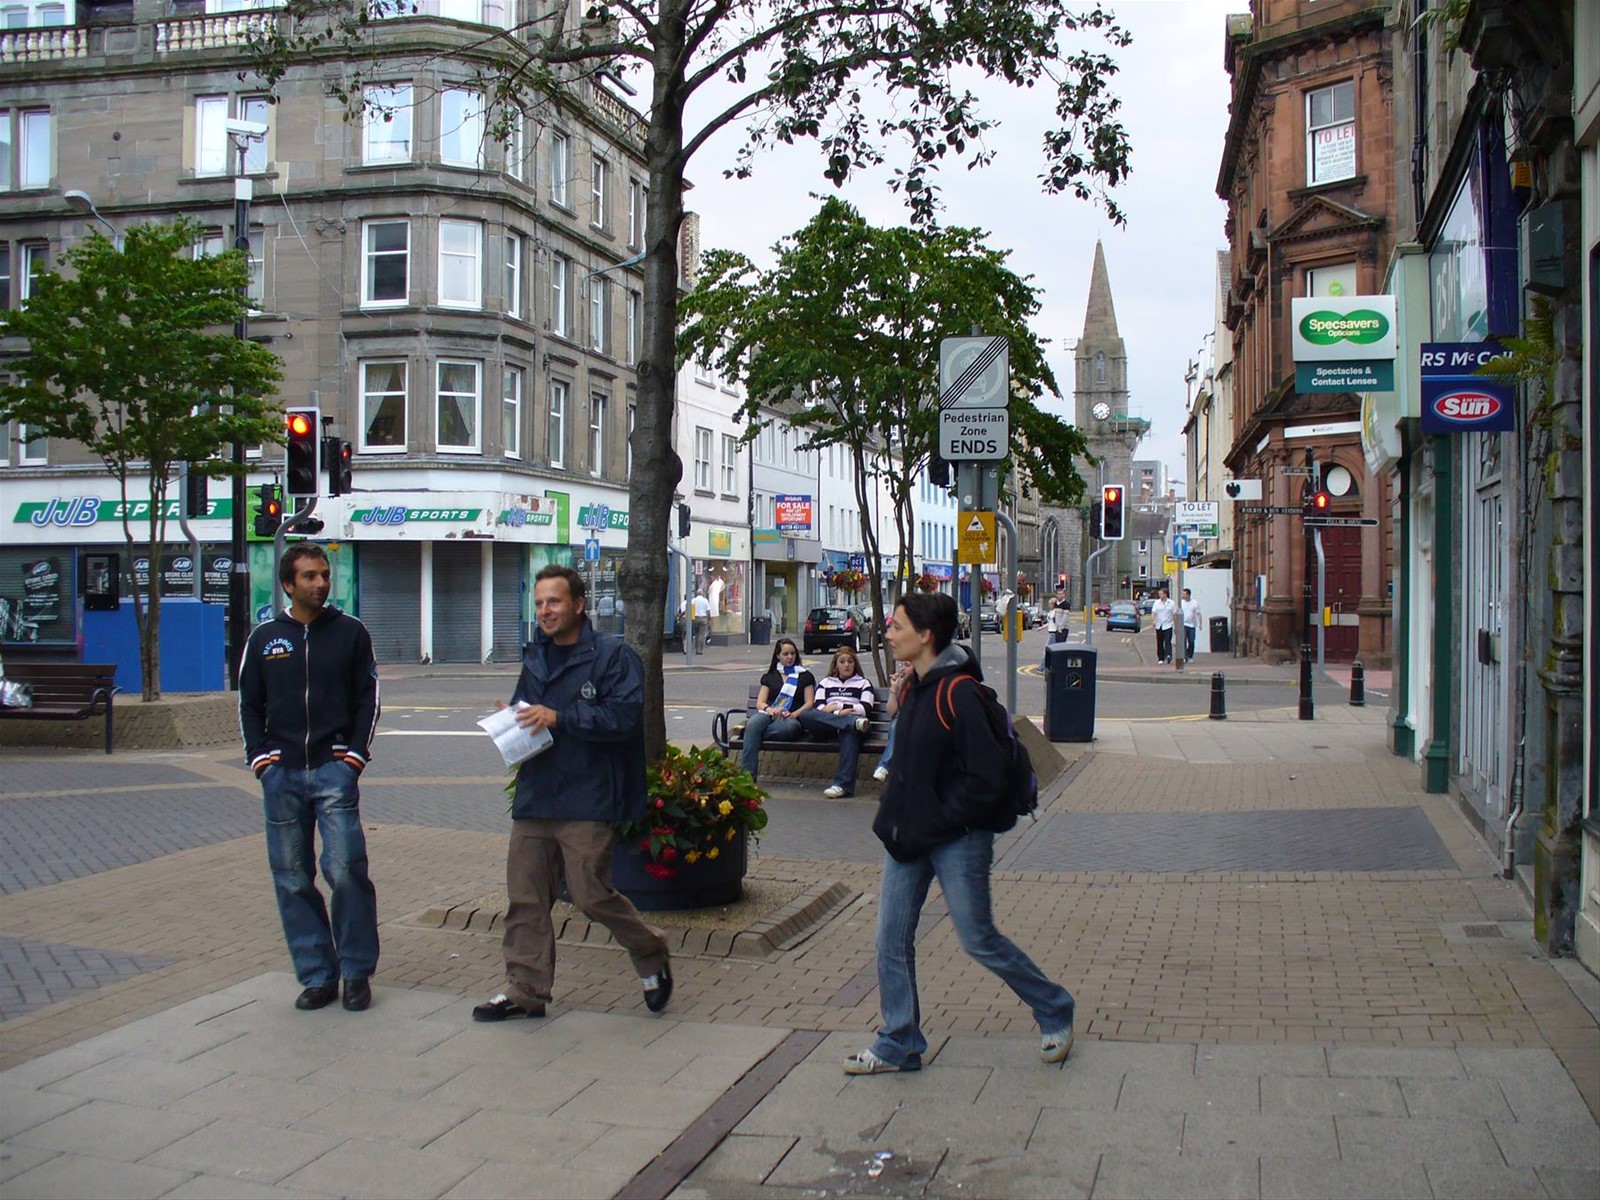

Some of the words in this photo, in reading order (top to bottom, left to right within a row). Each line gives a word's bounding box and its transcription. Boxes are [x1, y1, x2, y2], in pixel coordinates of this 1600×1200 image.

[1317, 130, 1332, 145] TO
[1309, 318, 1379, 332] Specsavers
[1327, 329, 1360, 337] Opticians
[1420, 352, 1446, 366] RS
[1316, 367, 1363, 377] Spectacles
[1365, 366, 1372, 374] &
[1311, 378, 1345, 386] Contact
[1346, 377, 1377, 385] Lenses
[1443, 398, 1490, 415] Sun
[944, 413, 1004, 423] Pedestrian
[960, 426, 987, 436] Zone
[951, 440, 997, 454] ENDS
[31, 496, 101, 527] JJB
[114, 502, 217, 517] SPRS
[1183, 503, 1195, 511] TO
[1197, 503, 1211, 511] LET
[361, 506, 405, 525] JJB
[410, 510, 469, 520] SPORTS
[506, 507, 527, 527] JJB
[526, 514, 550, 523] SPORTS
[582, 502, 609, 530] JJB
